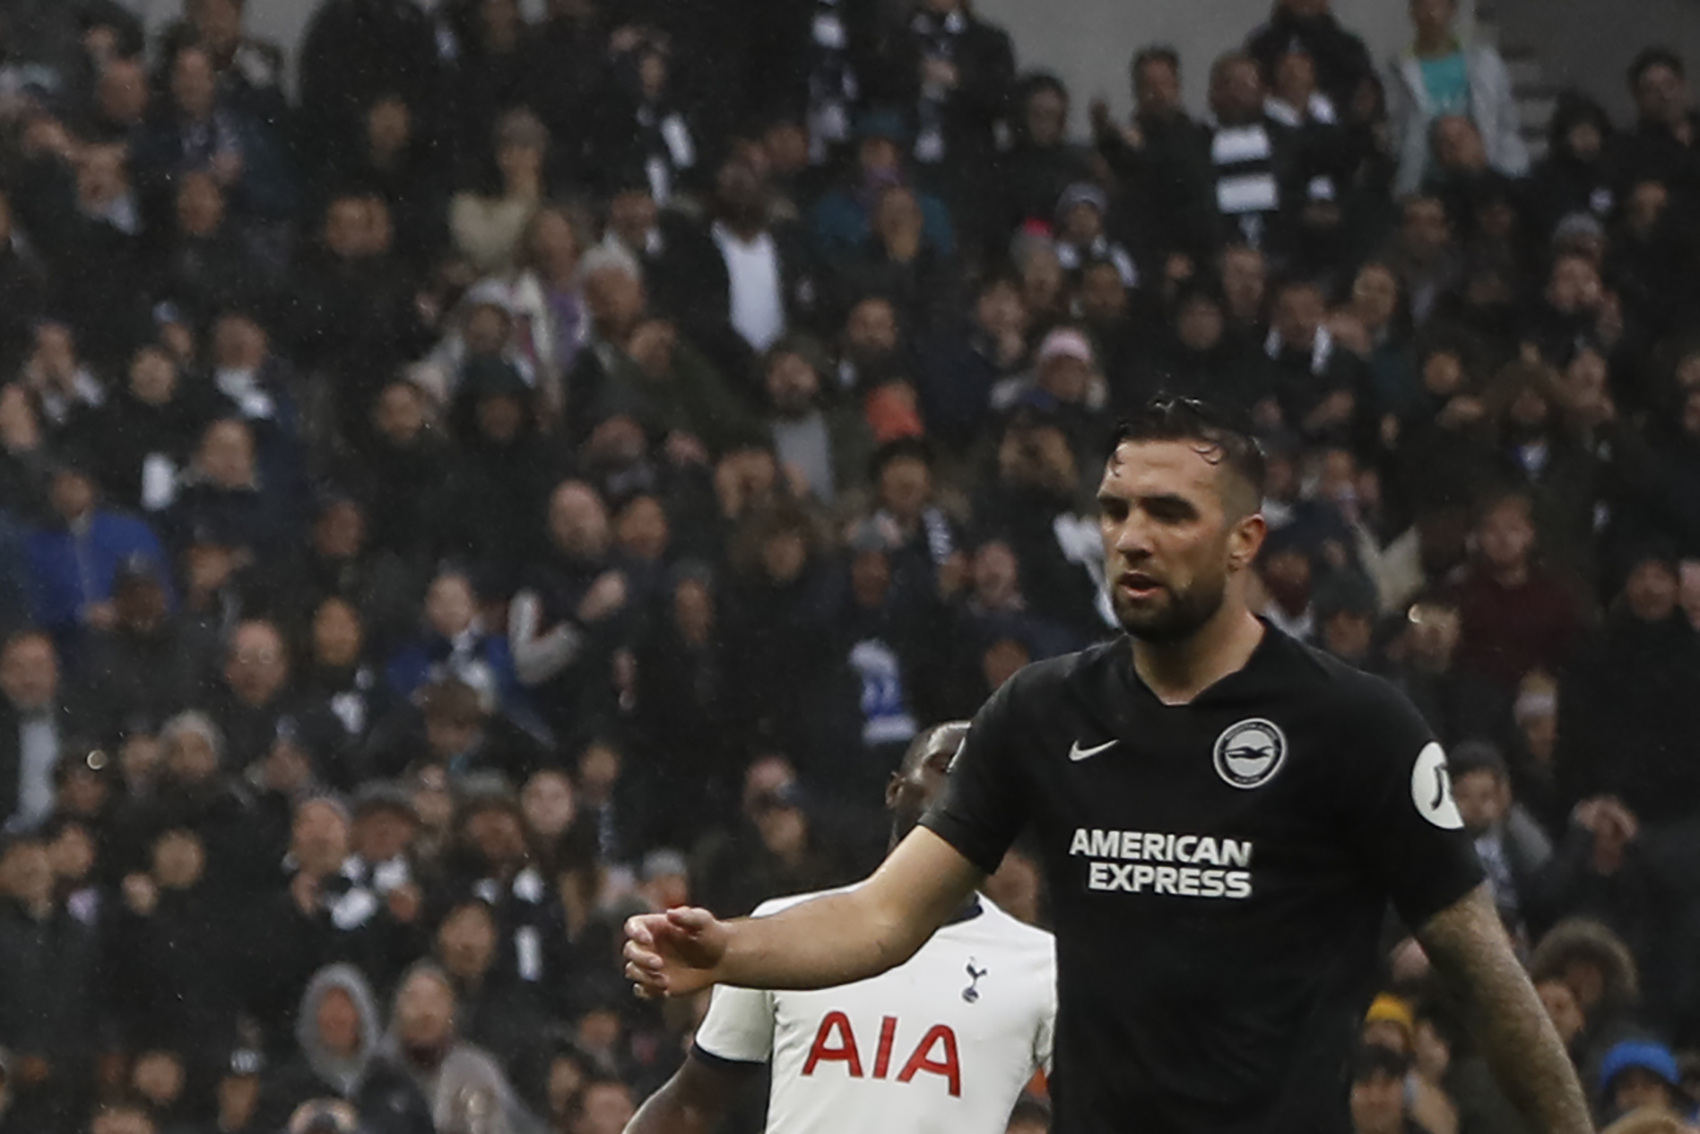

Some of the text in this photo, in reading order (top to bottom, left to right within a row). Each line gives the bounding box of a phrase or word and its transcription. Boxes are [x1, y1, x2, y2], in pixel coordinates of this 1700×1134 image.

[1069, 828, 1252, 867] AMERICAN
[1088, 862, 1252, 898] EXPRESS
[802, 1010, 962, 1098] AIA
